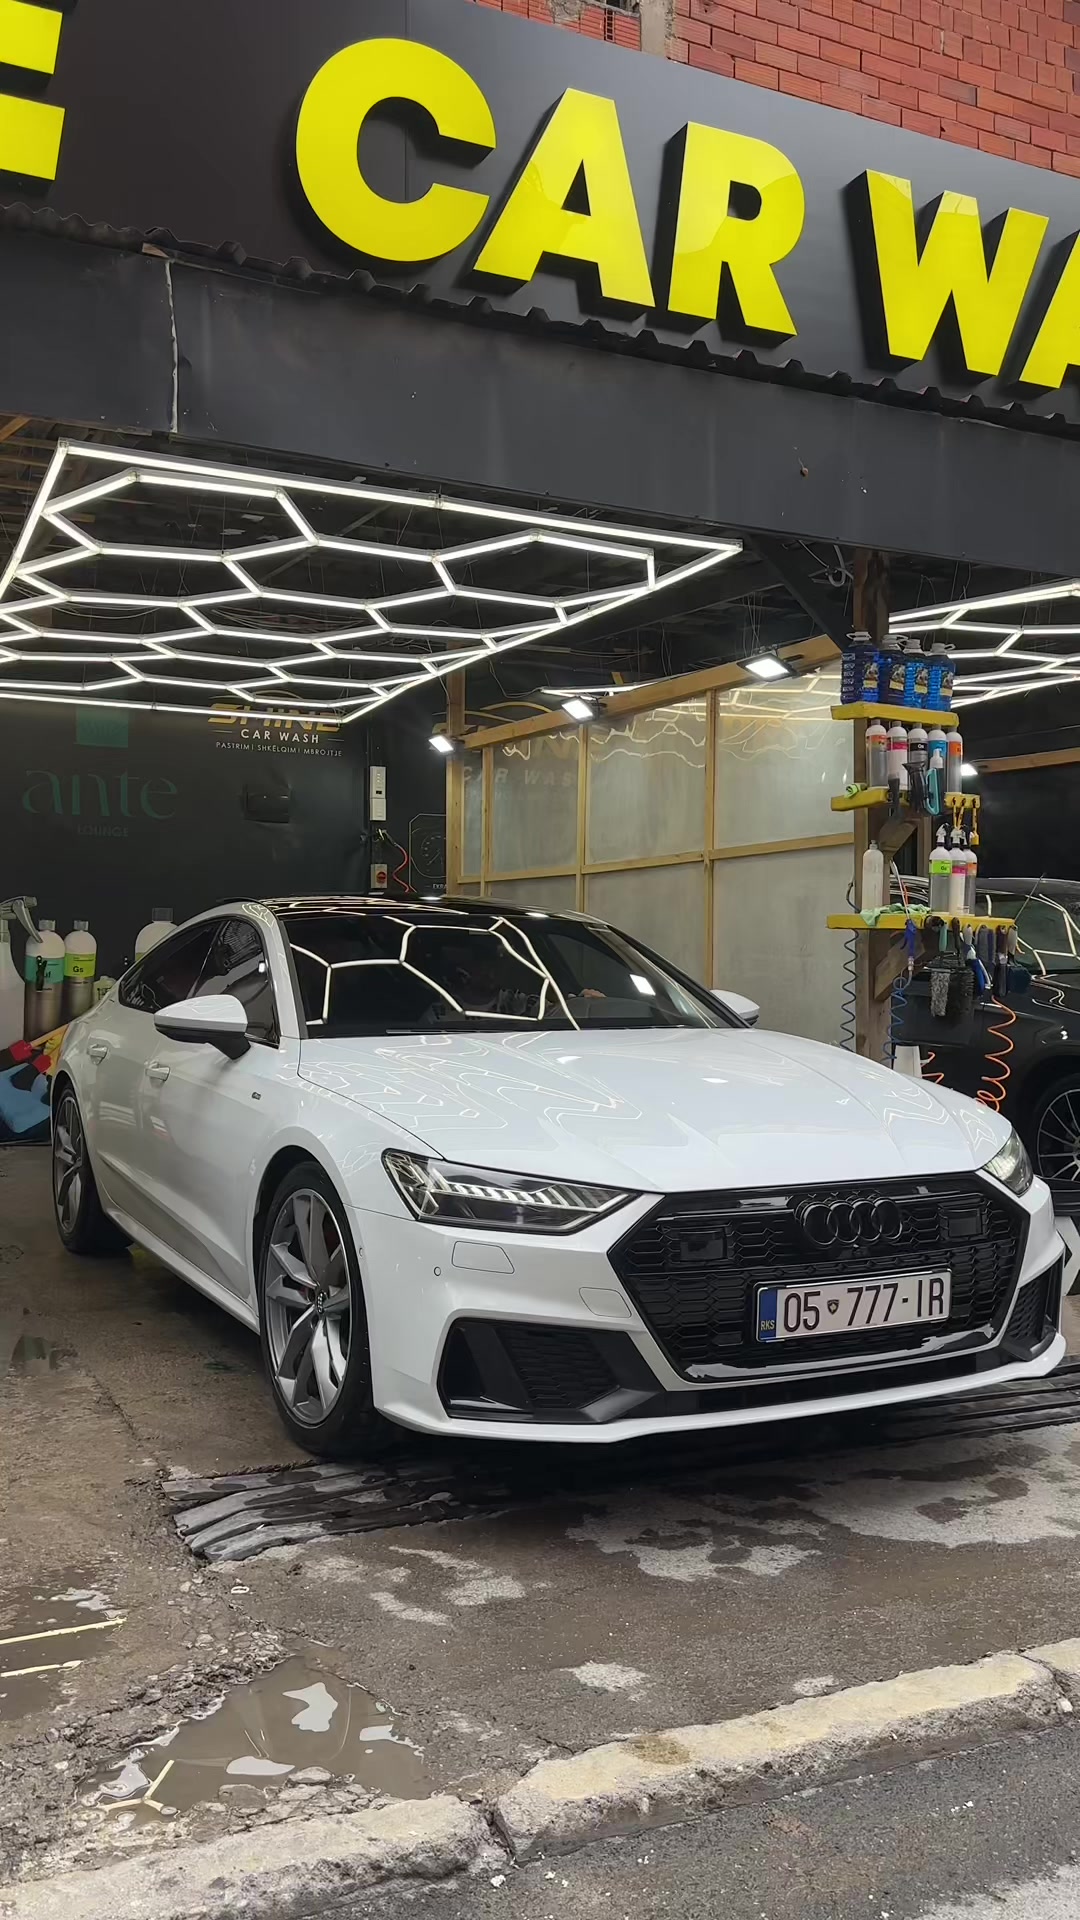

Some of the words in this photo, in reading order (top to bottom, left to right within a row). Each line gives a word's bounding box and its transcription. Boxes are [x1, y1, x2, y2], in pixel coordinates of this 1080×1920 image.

[296, 37, 804, 336] CAR
[241, 729, 271, 740] CAR
[280, 732, 319, 743] WASH
[216, 741, 250, 750] PASTRIM
[304, 748, 342, 757] MBROJTJE
[73, 965, 84, 973] Gs
[783, 1290, 821, 1332] 05
[760, 1319, 775, 1331] RKS
